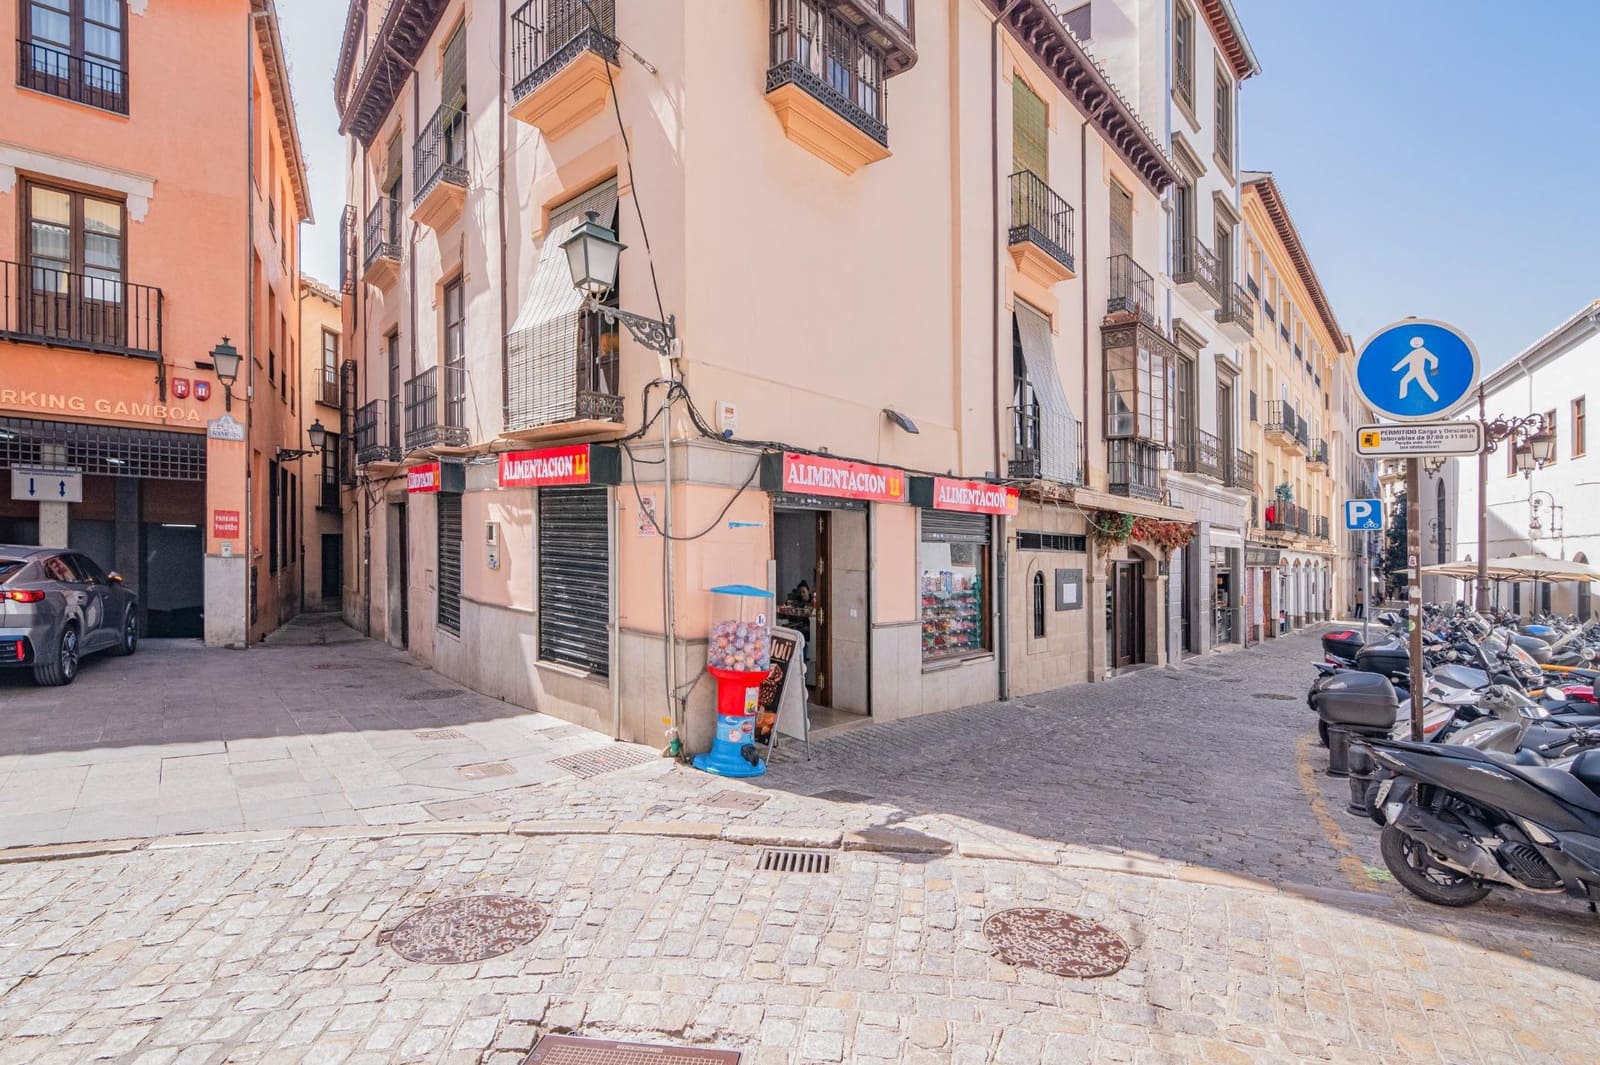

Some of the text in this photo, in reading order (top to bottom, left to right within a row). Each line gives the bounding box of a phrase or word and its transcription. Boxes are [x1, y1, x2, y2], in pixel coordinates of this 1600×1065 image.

[0, 389, 201, 422] RKING GAMBOA
[503, 453, 586, 480] ALIMENTACION LI
[787, 462, 900, 497] ALIMENTACION LI
[939, 485, 1006, 508] ALIMENTACION
[1349, 501, 1372, 526] P
